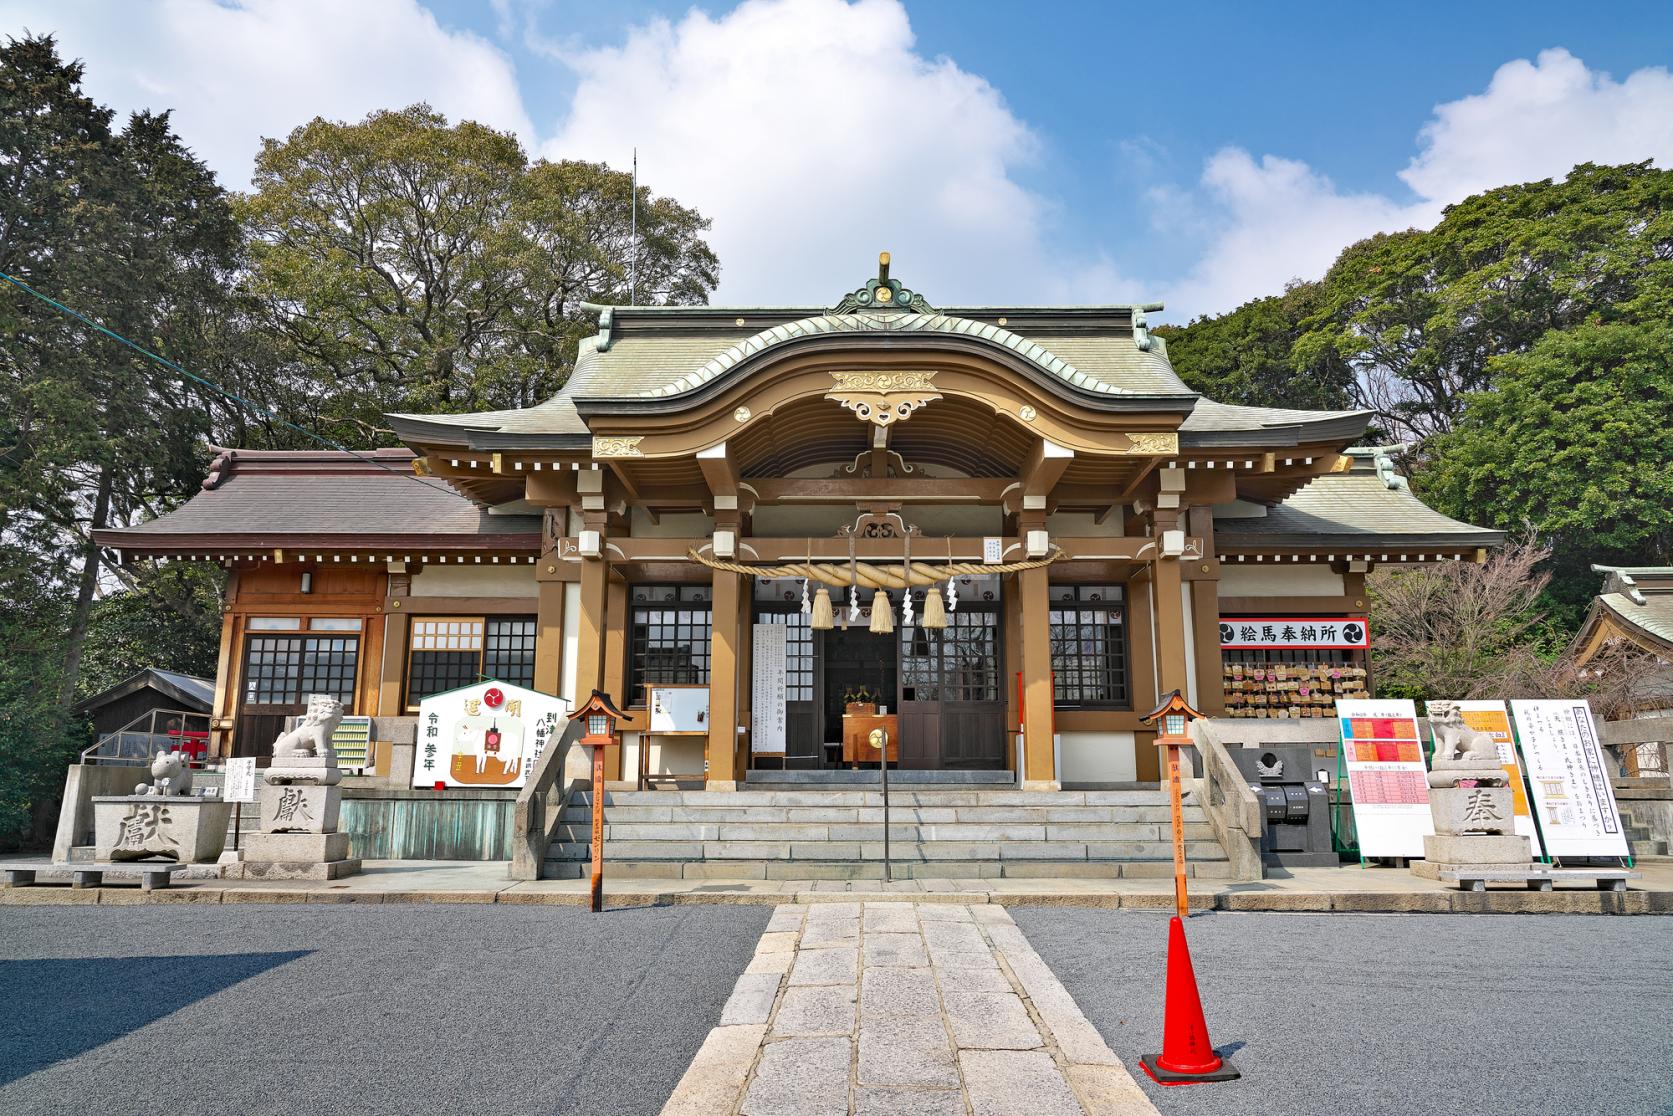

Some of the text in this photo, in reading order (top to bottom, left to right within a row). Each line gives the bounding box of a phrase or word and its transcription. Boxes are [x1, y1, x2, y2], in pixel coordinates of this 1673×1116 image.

[1240, 625, 1337, 642] 絵馬奉納所
[424, 712, 439, 771] 令和参年
[1462, 789, 1504, 826] 奉
